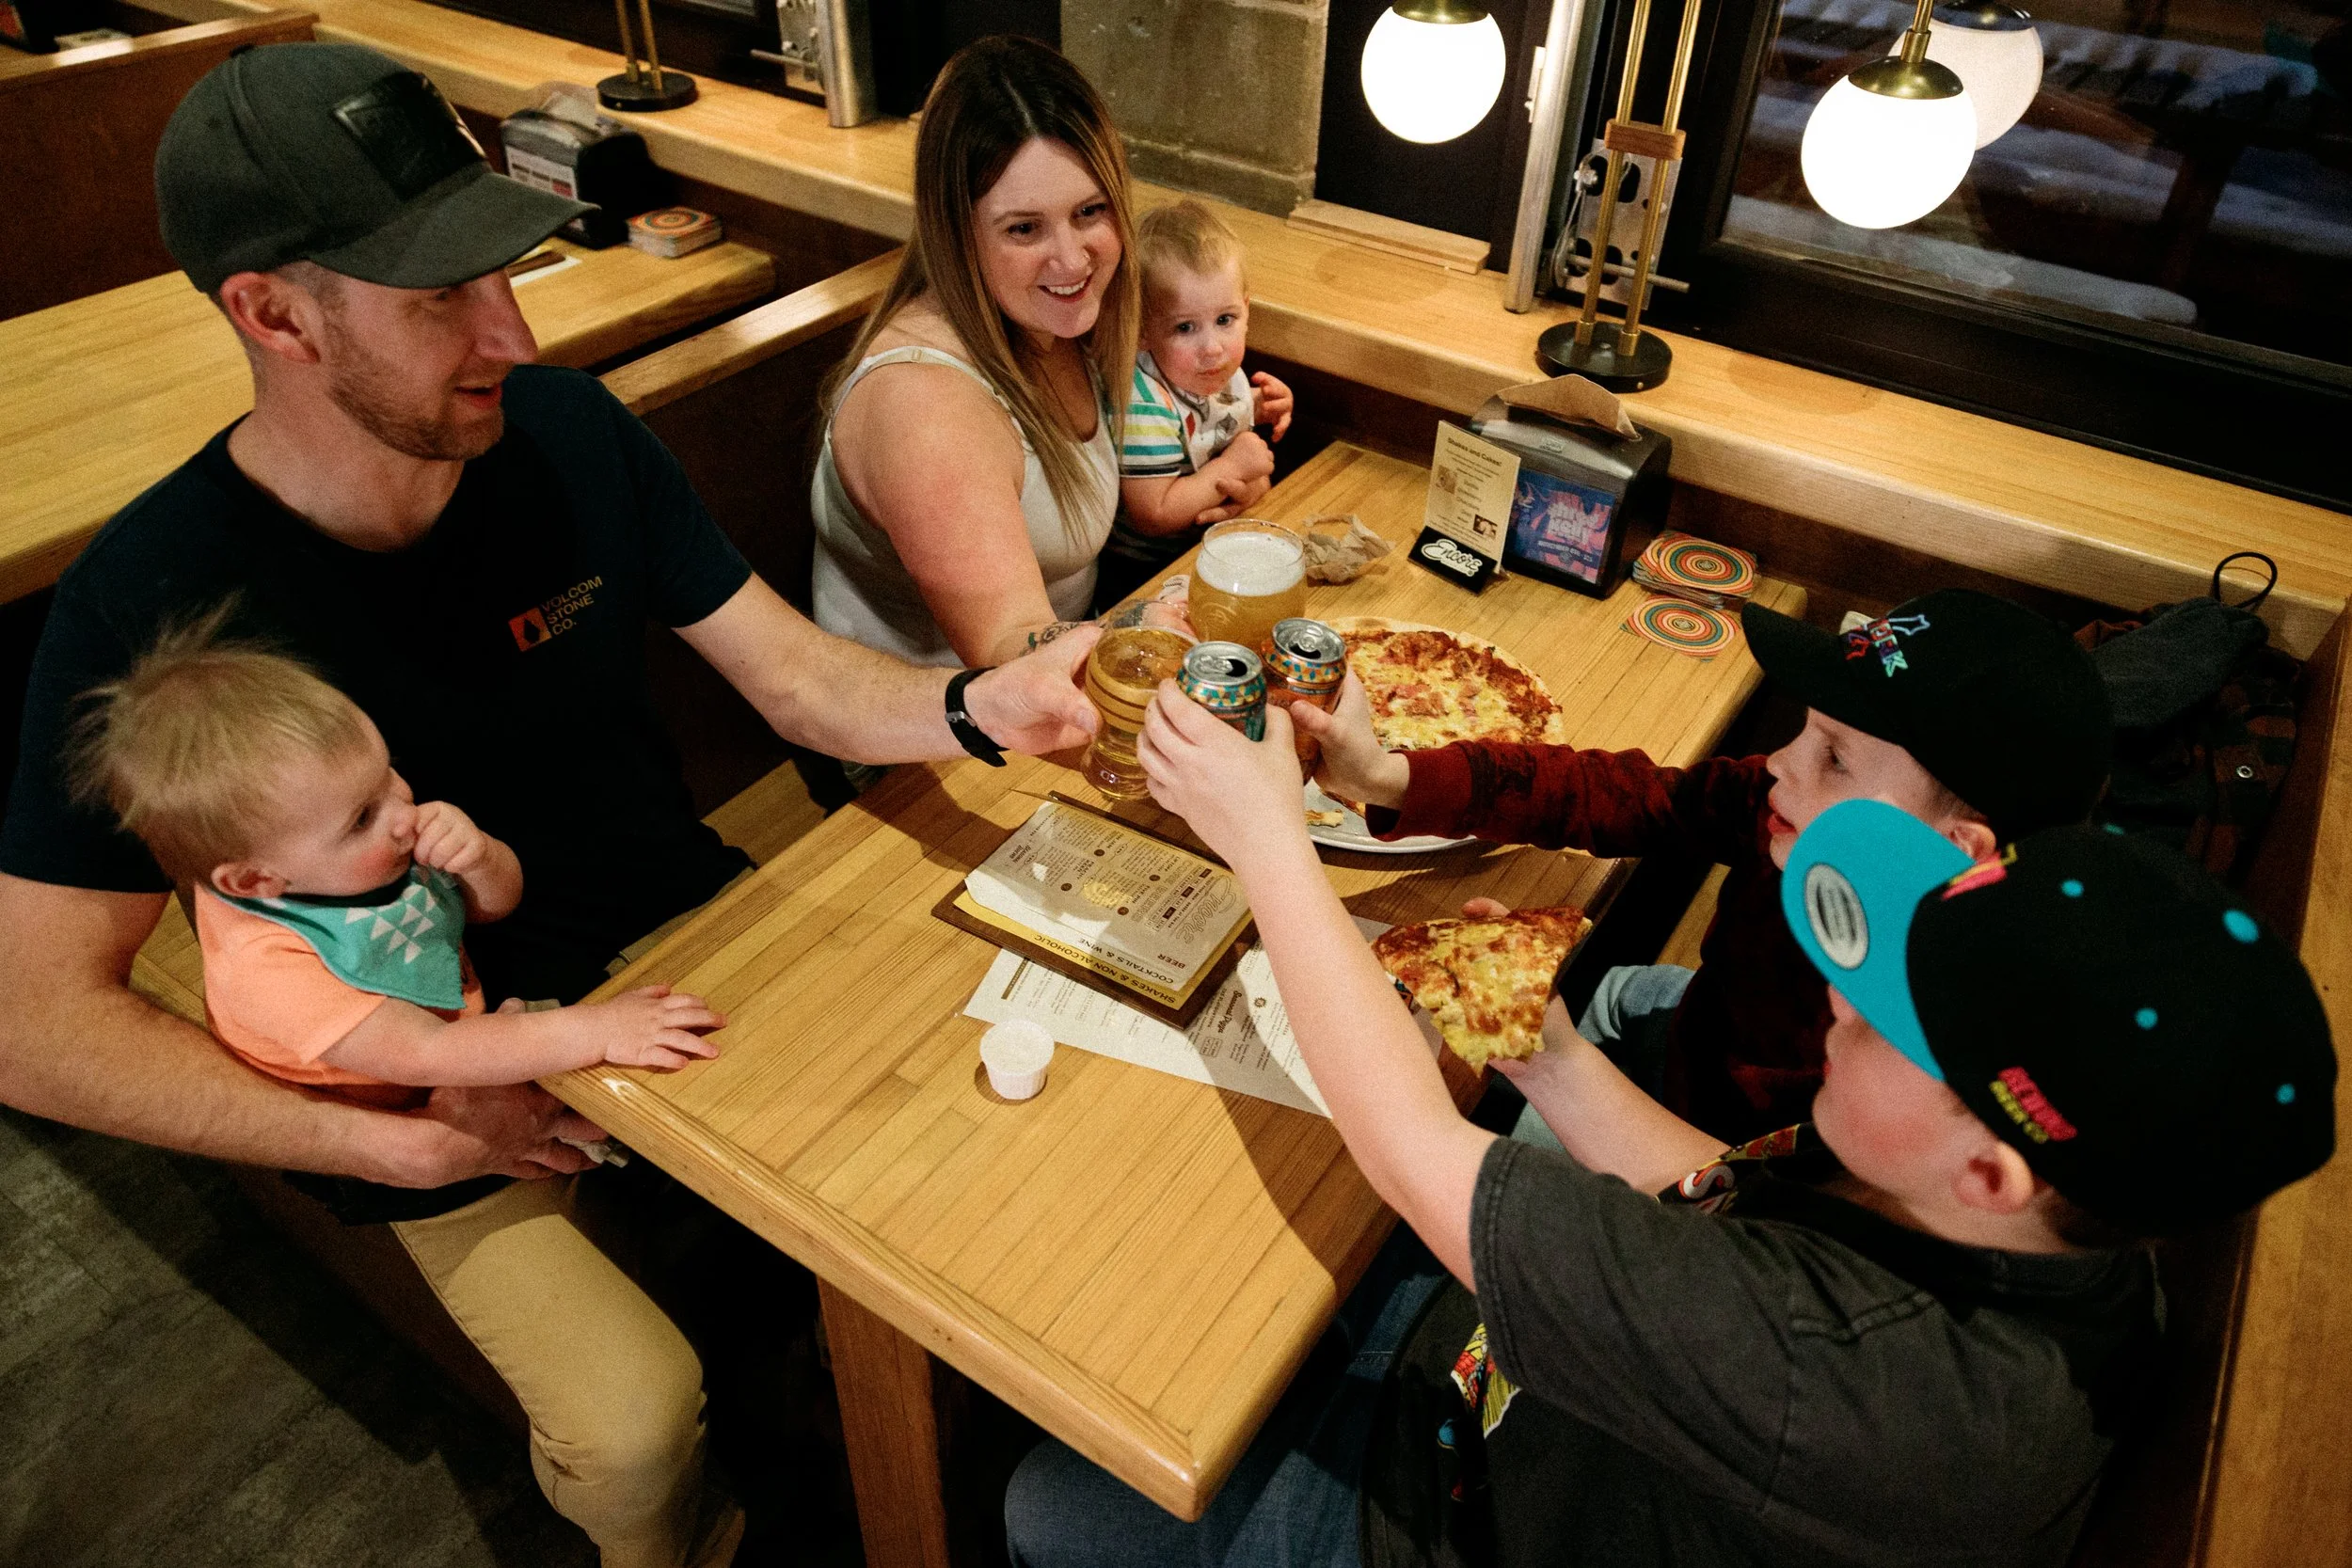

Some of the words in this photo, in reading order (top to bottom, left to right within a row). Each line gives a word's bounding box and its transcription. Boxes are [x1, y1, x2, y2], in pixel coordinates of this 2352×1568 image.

[1447, 436, 1469, 451] Shakes
[1469, 449, 1481, 458] and
[1421, 539, 1483, 572] Encore
[541, 576, 603, 611] VOLCOM
[548, 594, 595, 624] STONE
[552, 618, 577, 635] CO.
[1174, 875, 1236, 944] Encore
[1034, 935, 1093, 965] ALCOHOLIC
[1079, 938, 1102, 953] WINE
[1094, 962, 1118, 976] NON
[1116, 957, 1174, 984] COCKTAILS
[1157, 953, 1186, 969] BEER
[1131, 979, 1176, 1004] SHAKES
[1226, 990, 1242, 1017] Seasonal
